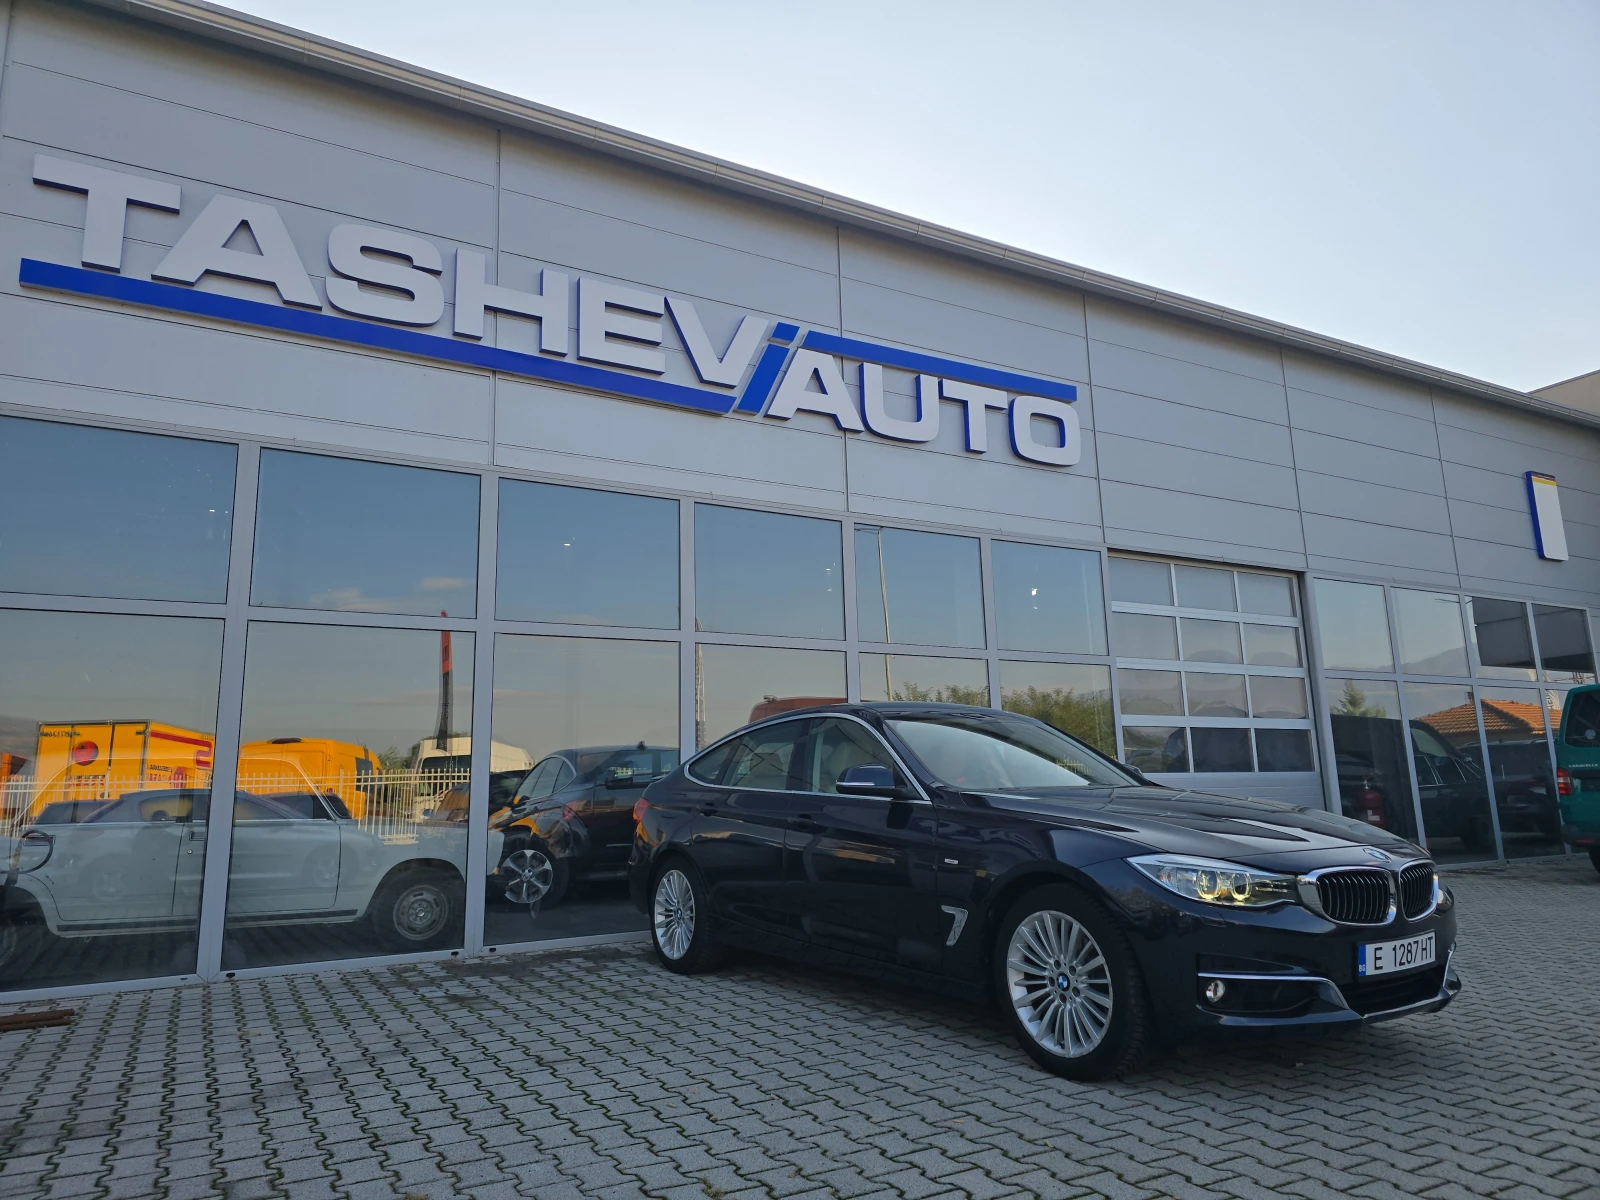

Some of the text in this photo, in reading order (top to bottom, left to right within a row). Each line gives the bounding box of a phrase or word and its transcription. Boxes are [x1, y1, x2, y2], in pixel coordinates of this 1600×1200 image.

[32, 153, 770, 389] TASHEV
[763, 346, 1082, 467] AUTO
[1374, 947, 1383, 971] E
